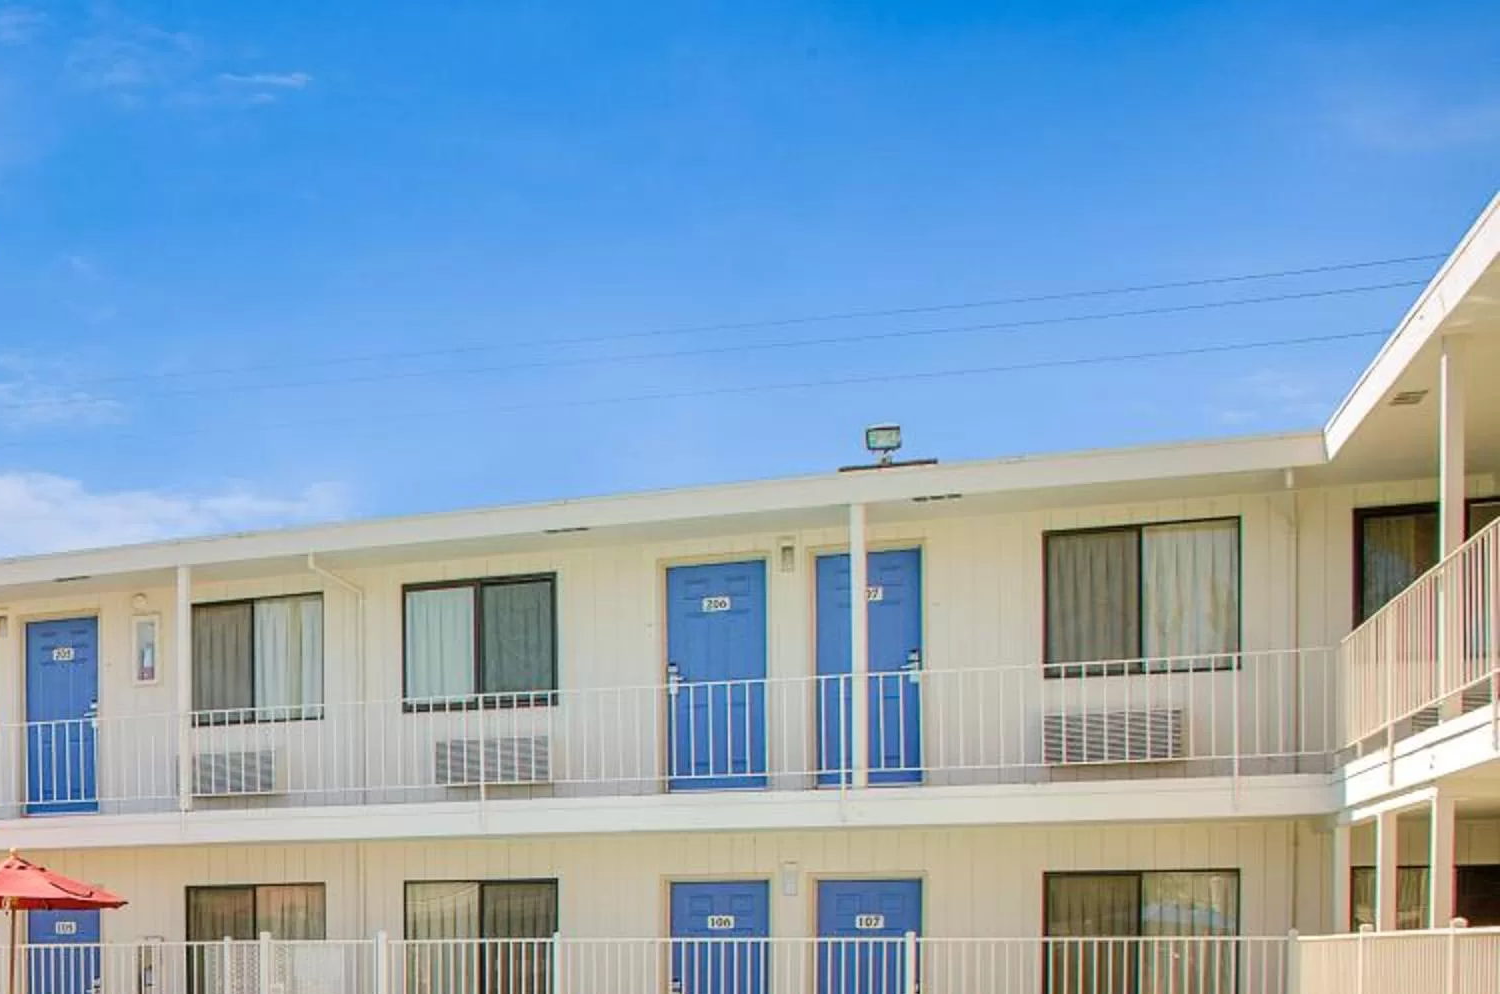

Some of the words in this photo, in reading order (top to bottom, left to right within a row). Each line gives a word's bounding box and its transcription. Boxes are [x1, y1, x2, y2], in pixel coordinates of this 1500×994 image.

[706, 599, 728, 609] 206
[710, 917, 731, 928] 106
[858, 917, 881, 928] 107
